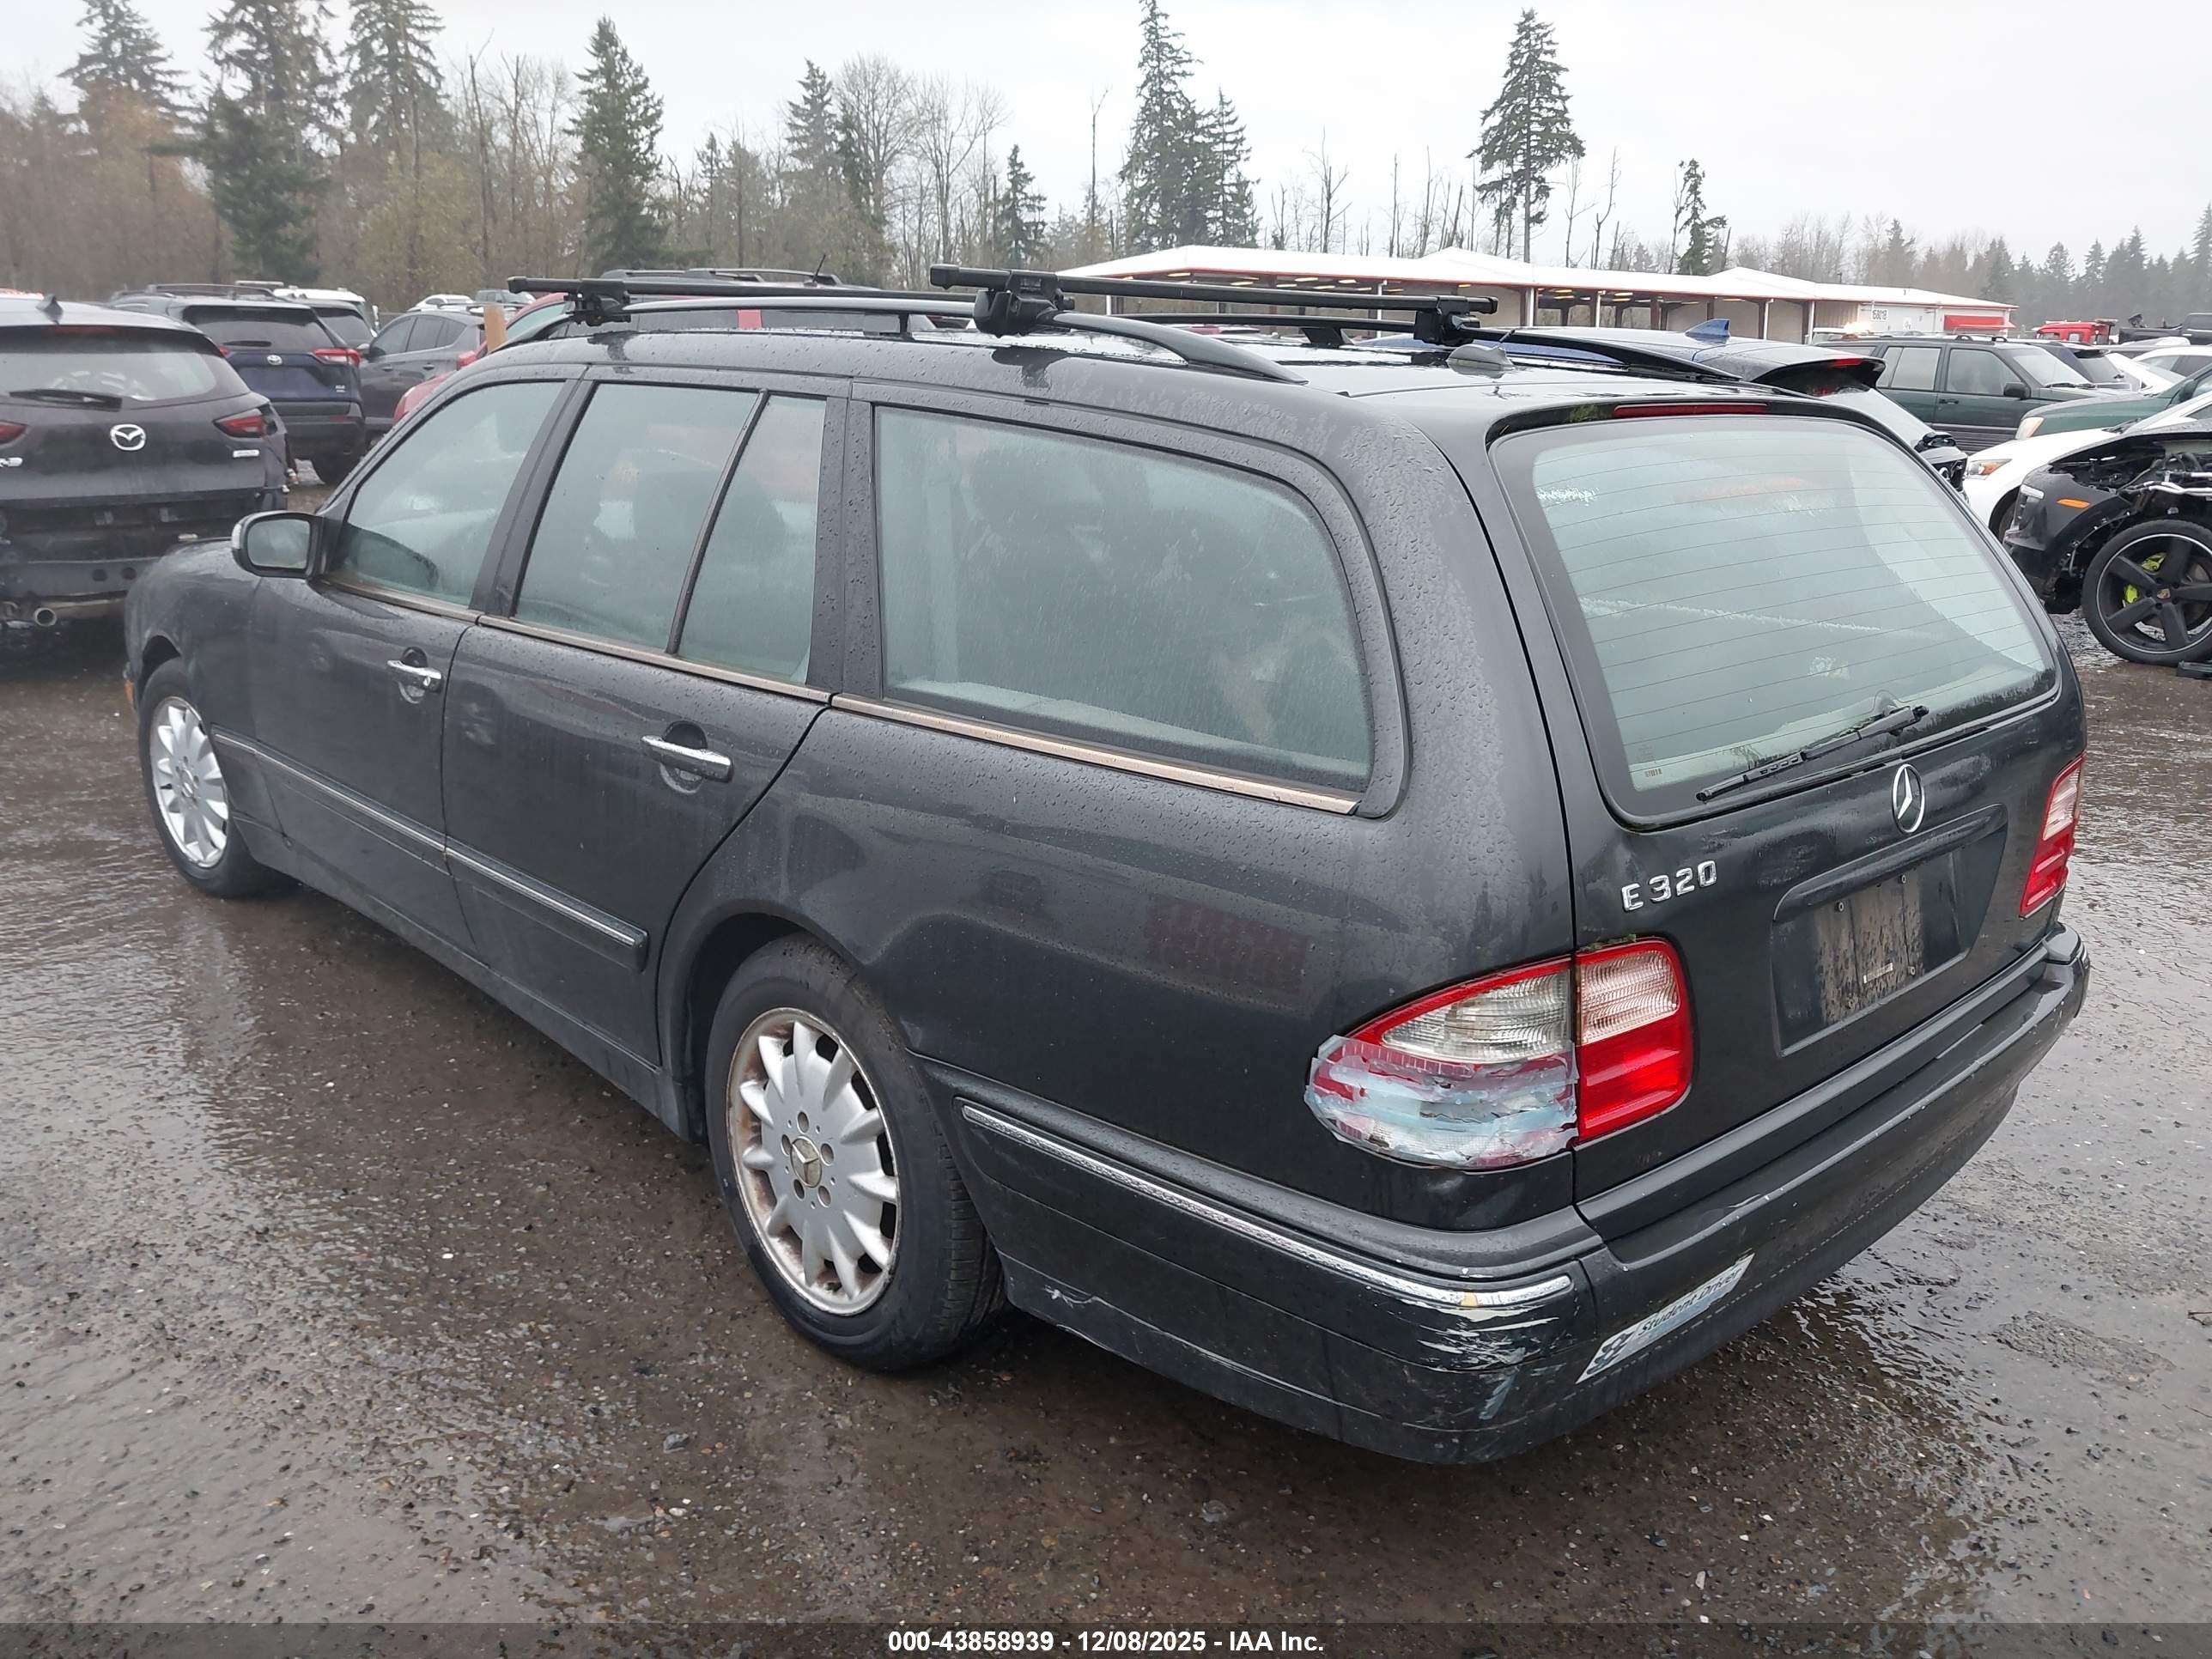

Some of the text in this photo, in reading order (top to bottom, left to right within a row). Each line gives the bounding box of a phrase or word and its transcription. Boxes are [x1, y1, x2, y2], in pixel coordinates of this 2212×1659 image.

[1621, 860, 1717, 912] E 320
[1637, 1267, 1742, 1336] Student Driver
